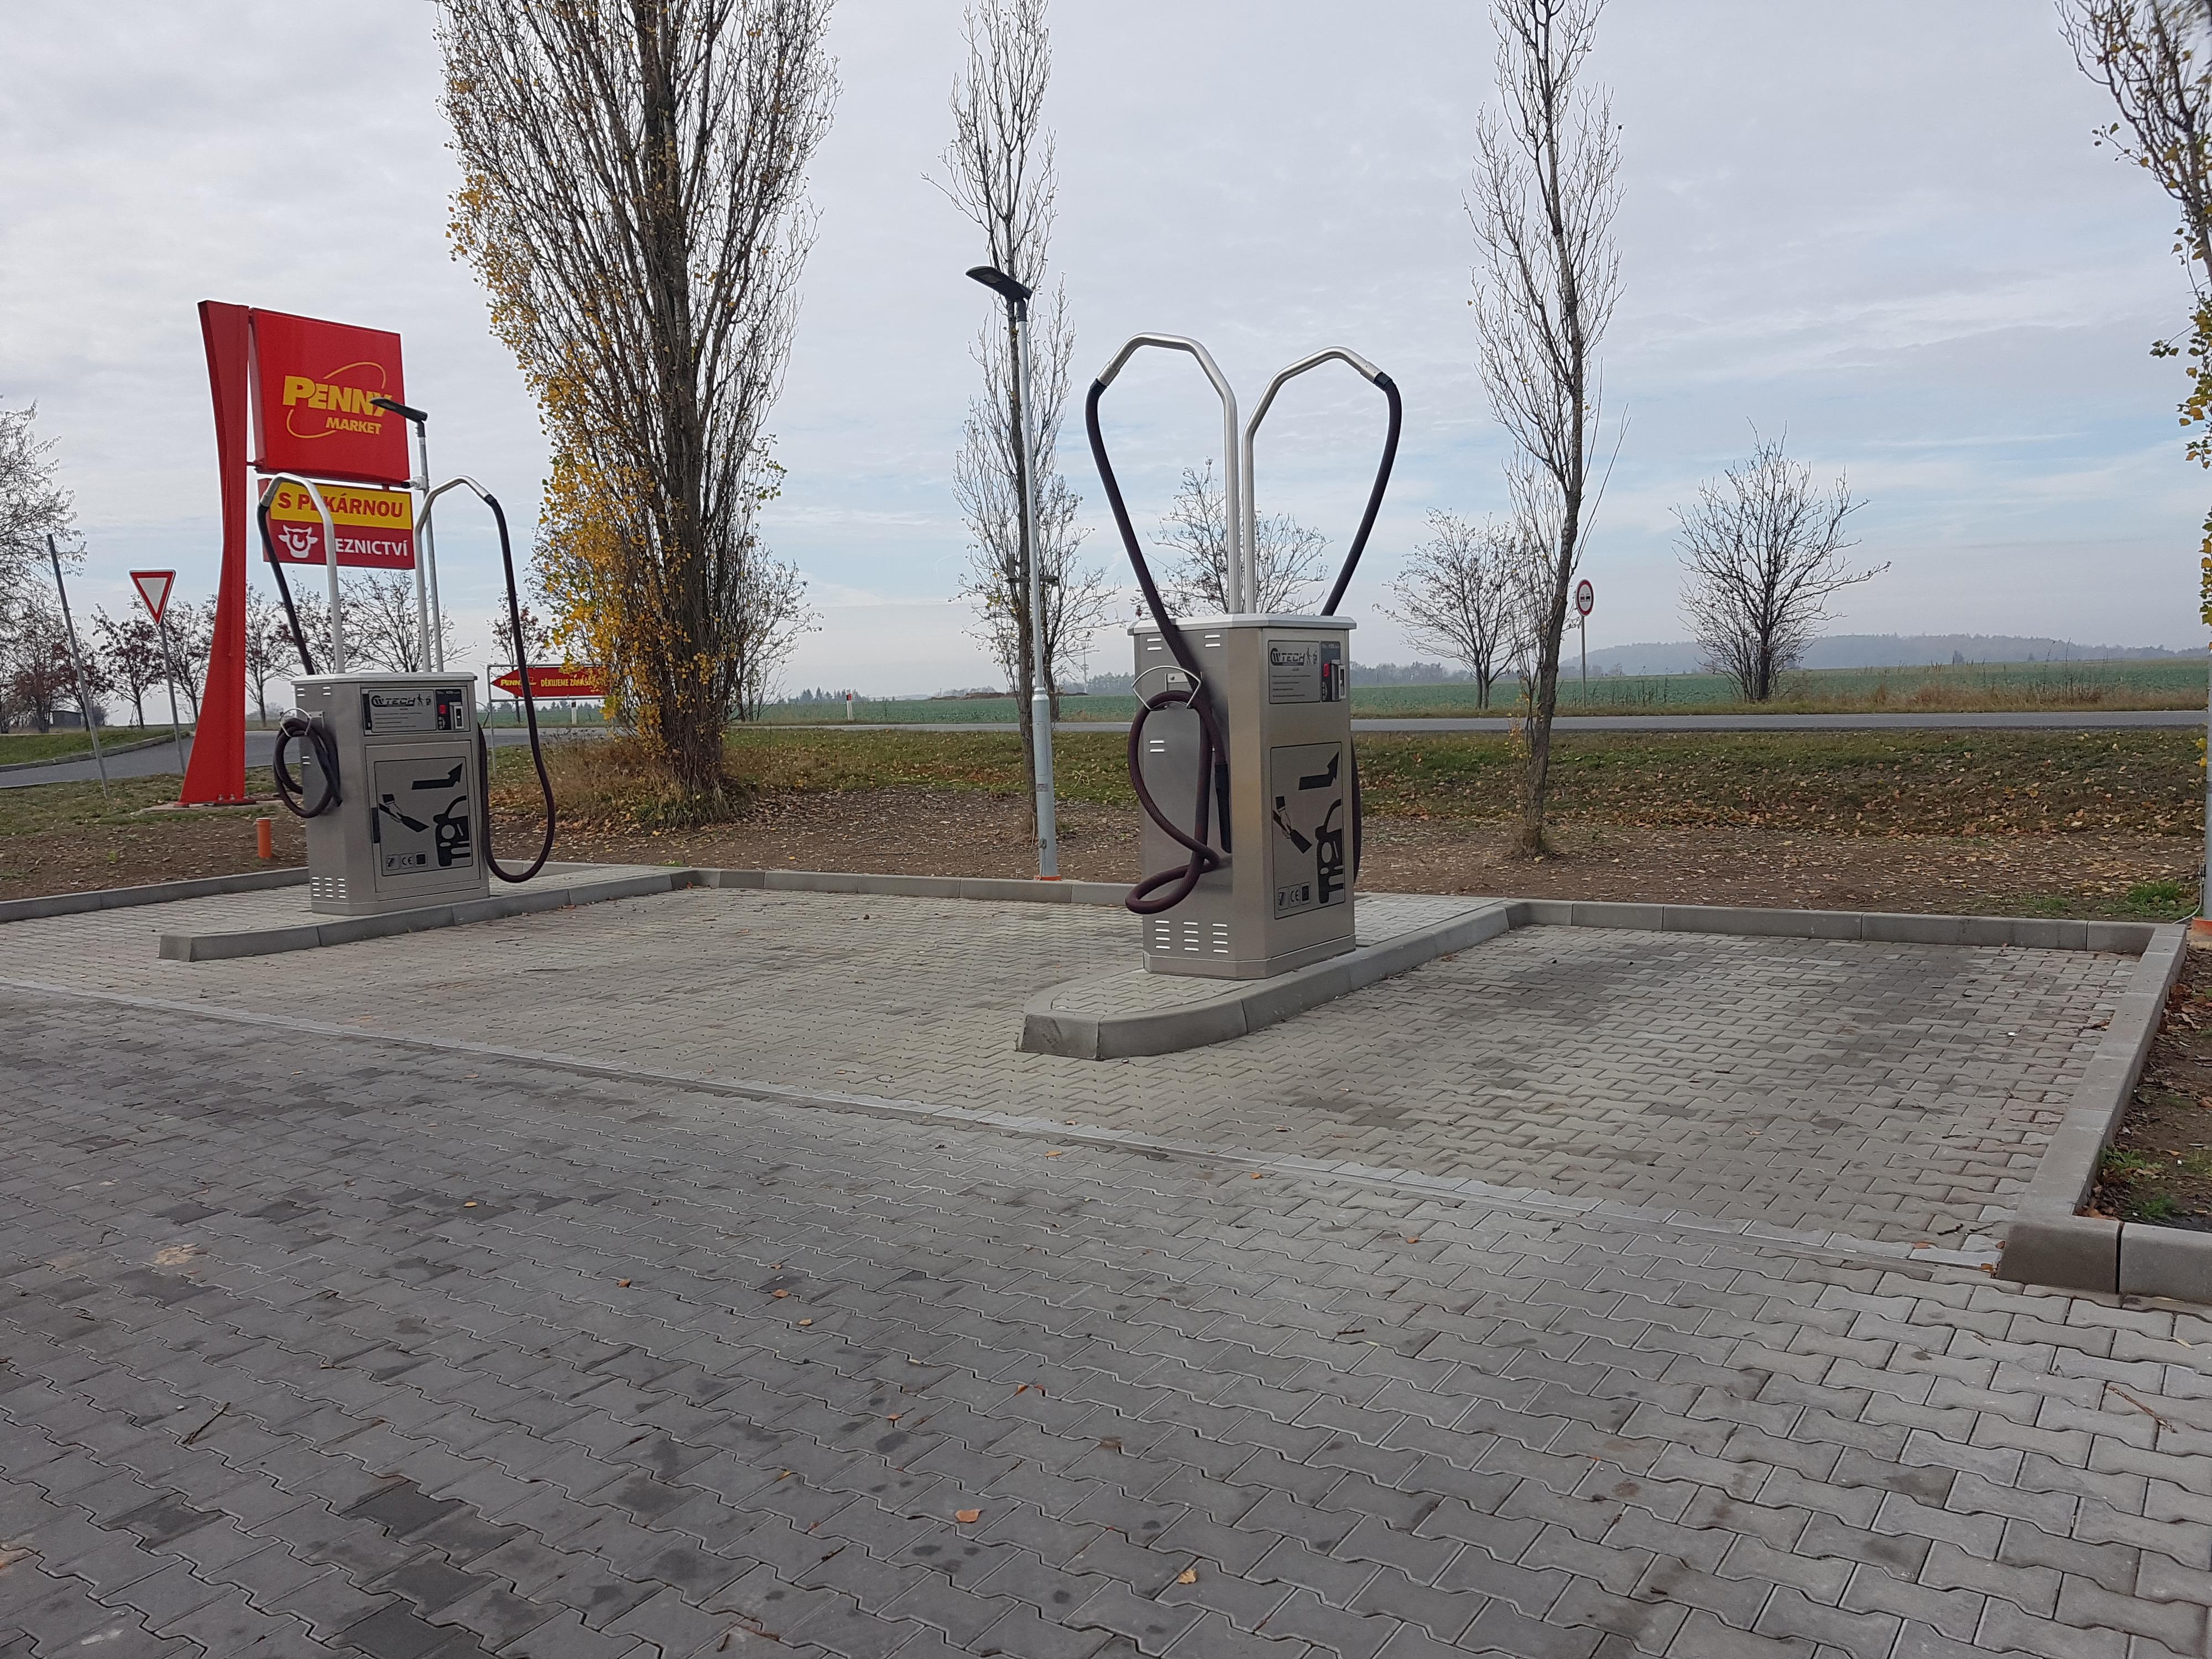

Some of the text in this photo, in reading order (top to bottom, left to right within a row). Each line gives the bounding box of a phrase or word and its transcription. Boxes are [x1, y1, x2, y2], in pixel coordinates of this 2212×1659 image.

[326, 417, 382, 435] MARKET
[278, 492, 291, 509] S
[335, 538, 408, 556] EZNICTVÍ
[540, 677, 569, 687] DĚKUJEME
